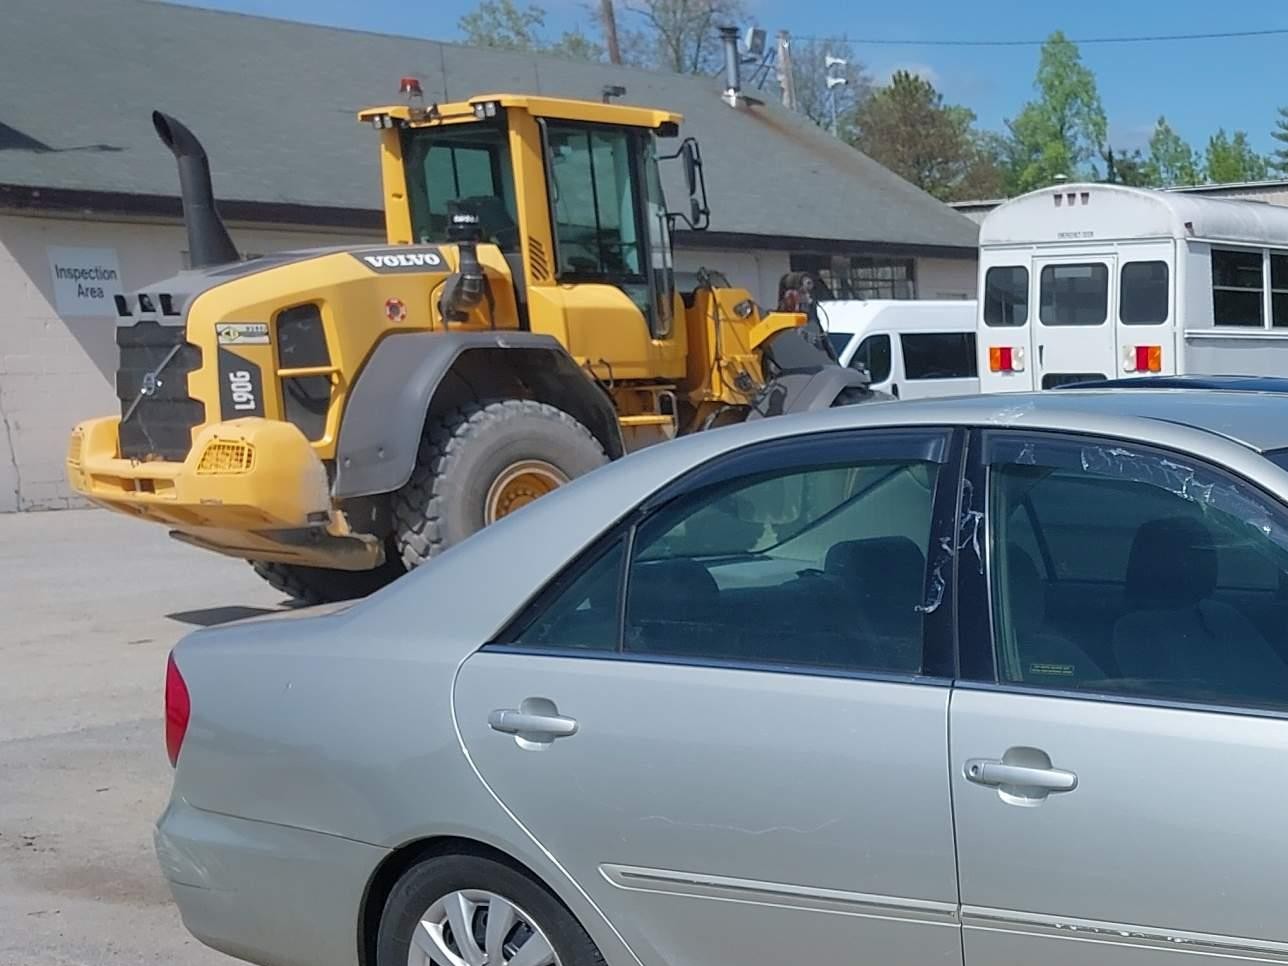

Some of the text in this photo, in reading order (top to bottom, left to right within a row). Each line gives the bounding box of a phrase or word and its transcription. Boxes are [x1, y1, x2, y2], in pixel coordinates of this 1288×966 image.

[363, 253, 441, 268] VOLVO
[55, 264, 118, 282] Inspection
[77, 283, 105, 299] Area
[228, 370, 256, 410] L90G
